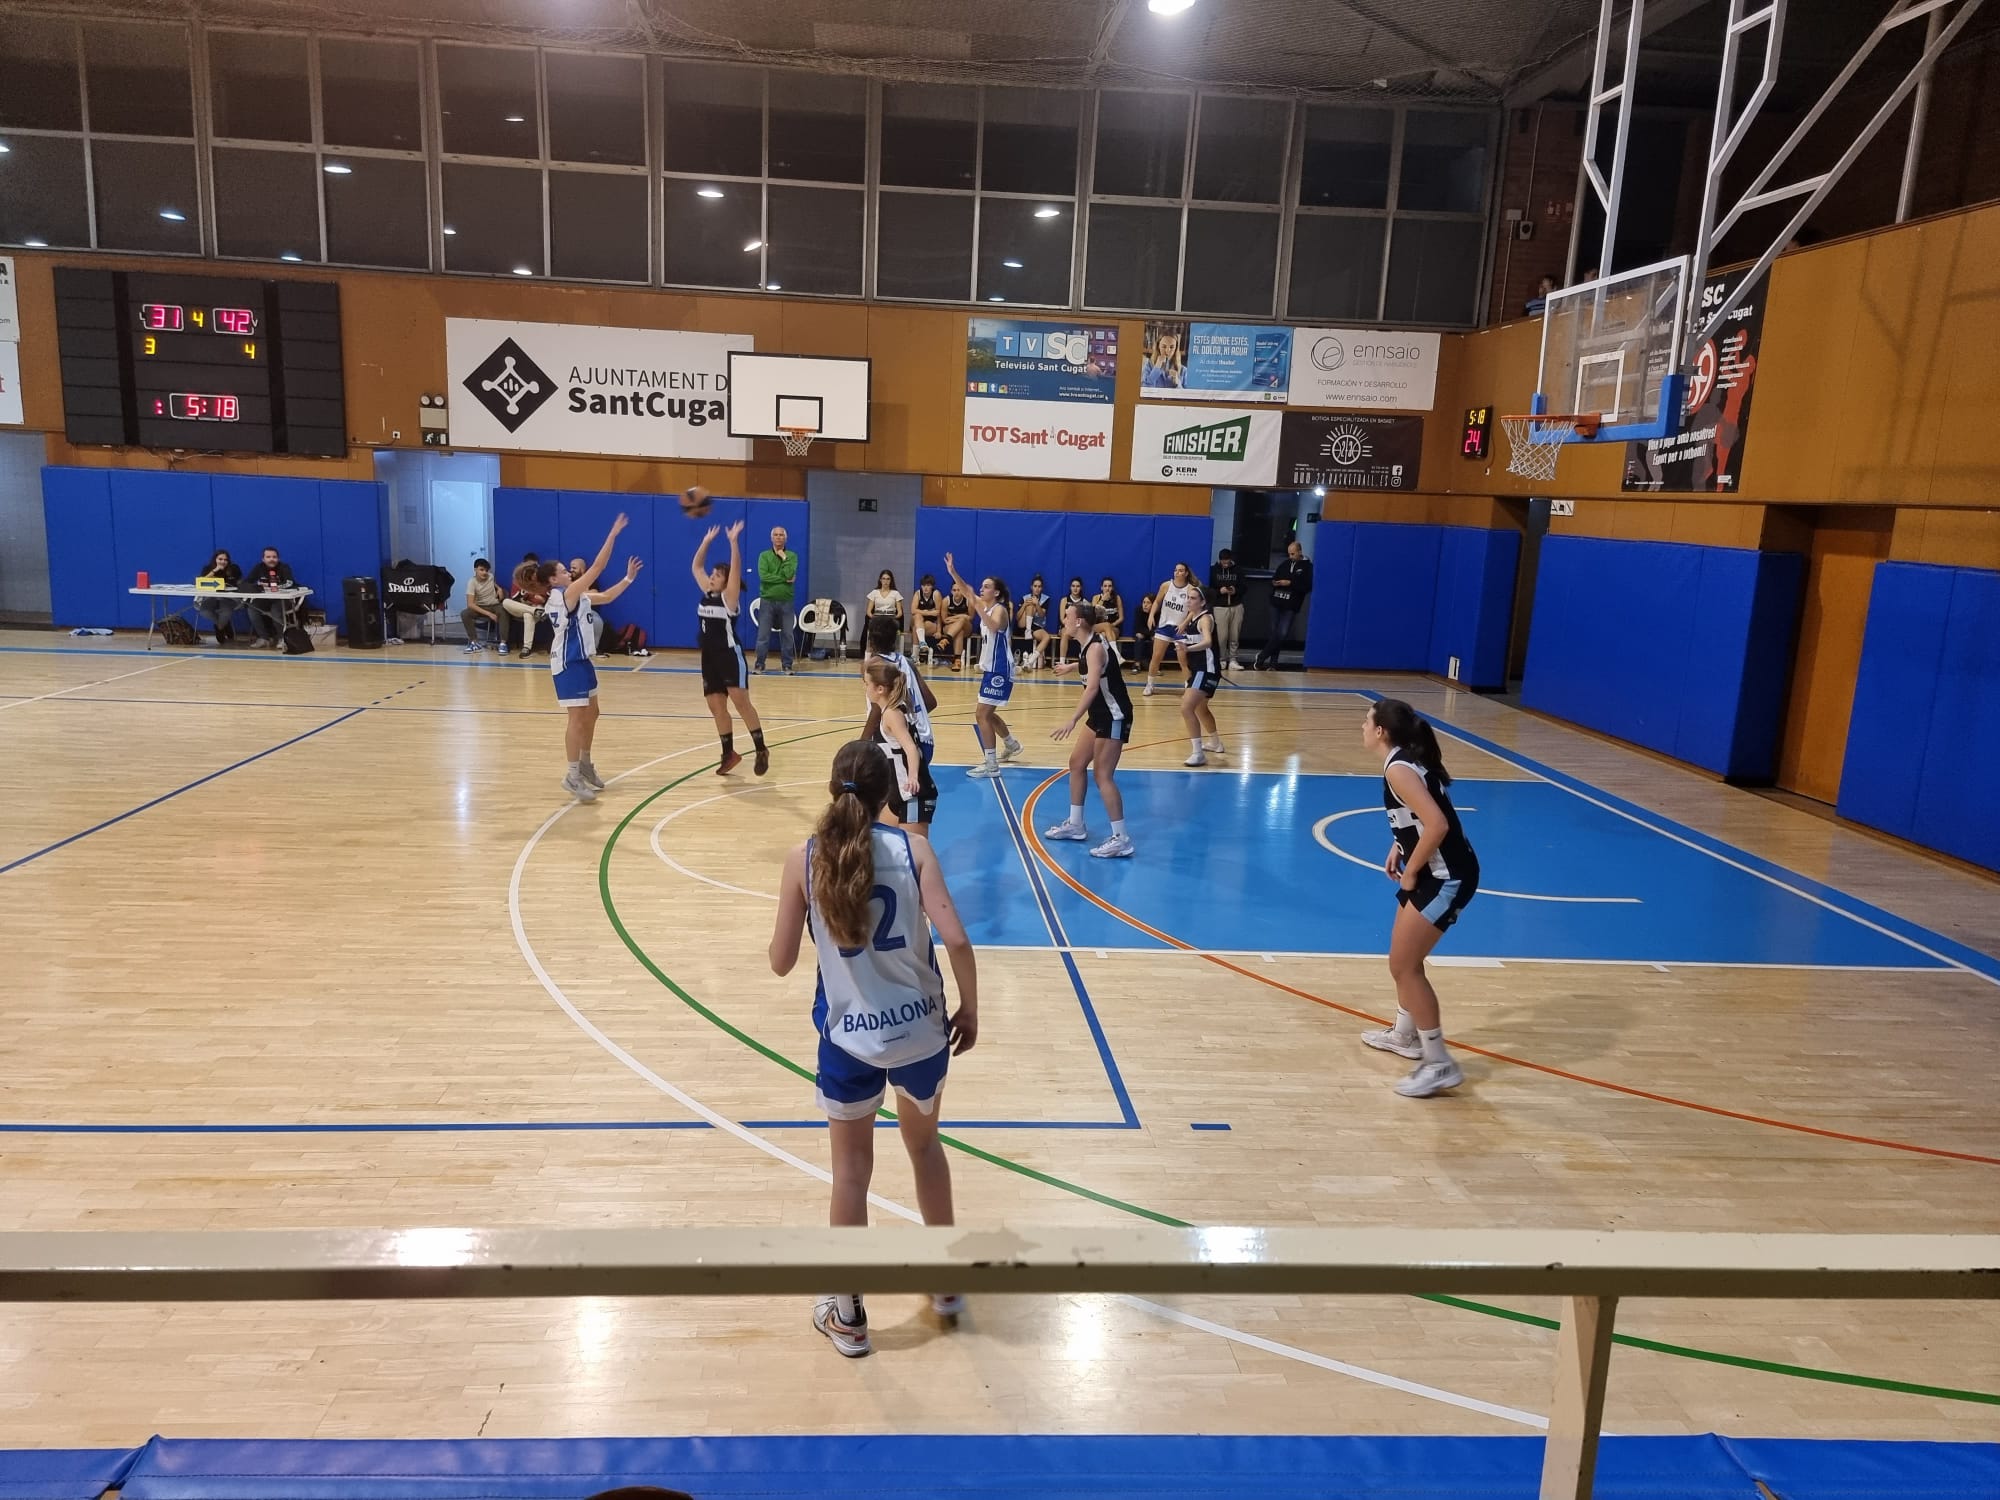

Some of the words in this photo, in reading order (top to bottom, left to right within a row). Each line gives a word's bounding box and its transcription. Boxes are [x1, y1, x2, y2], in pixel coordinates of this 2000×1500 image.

[1702, 284, 1725, 308] SC
[152, 307, 180, 328] 31
[192, 310, 203, 328] 4
[222, 311, 249, 333] 42
[144, 338, 155, 355] 3
[1211, 335, 1230, 346] DONDE
[244, 343, 255, 360] 4
[1192, 345, 1201, 355] AL
[1223, 346, 1230, 355] NI
[1230, 346, 1248, 357] AGUA
[1353, 343, 1421, 360] ennsaio
[995, 360, 1035, 370] Televisió
[1037, 363, 1058, 372] Sant
[1061, 364, 1087, 375] Cugat
[568, 365, 709, 392] AJUNTAMENT
[715, 373, 728, 391] D
[1317, 377, 1357, 388] FORMACIÓN
[1364, 380, 1408, 389] DESARROLLO
[1325, 392, 1398, 403] www.ennsaio.com
[188, 396, 236, 419] 5:18
[568, 387, 727, 426] SantCuga
[1468, 409, 1486, 425] 5:18
[970, 425, 1008, 443] TOT
[1010, 427, 1048, 445] Sant
[1057, 429, 1105, 451] Cugat
[1166, 425, 1242, 453] FINISHER
[1464, 429, 1481, 453] 24
[1677, 431, 1690, 445] amb
[1689, 424, 1718, 443] nosaltres!
[1668, 451, 1679, 465] per
[1678, 450, 1683, 462] a
[1176, 466, 1197, 474] KERN
[388, 582, 430, 593] SPALDING
[843, 994, 938, 1033] BADALONA
